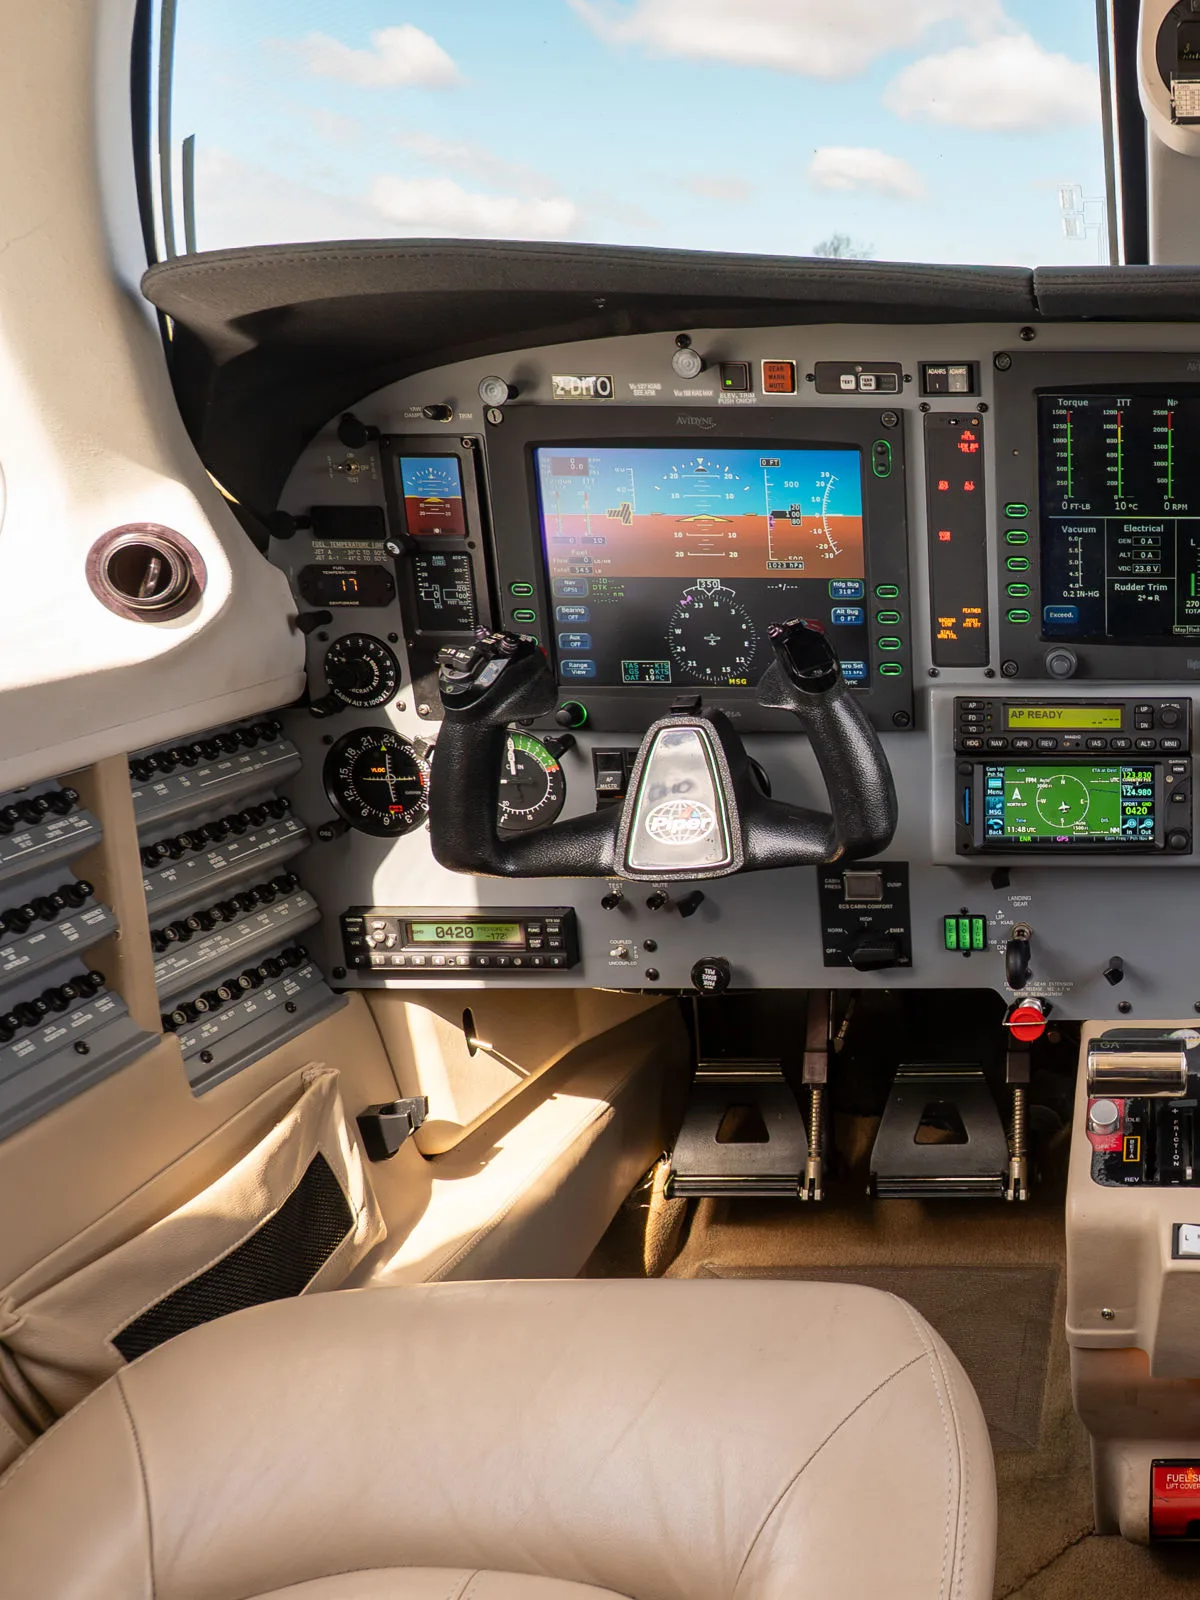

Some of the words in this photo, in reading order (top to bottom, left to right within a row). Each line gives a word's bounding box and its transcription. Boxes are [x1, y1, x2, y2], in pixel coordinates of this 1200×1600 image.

[1058, 399, 1088, 407] Torque
[1117, 399, 1132, 407] ITT
[676, 416, 714, 425] AVIDYNE
[1124, 524, 1164, 532] Electrical
[342, 578, 358, 591] 17
[700, 580, 718, 588] 350
[1114, 583, 1145, 591] Rudder
[334, 689, 351, 703] CABIN
[370, 697, 383, 705] 1000
[382, 690, 389, 699] FT
[1011, 710, 1025, 718] AP
[1028, 710, 1063, 719] READY
[361, 736, 373, 745] 21
[383, 734, 395, 742] 24
[340, 769, 348, 778] 15
[344, 790, 353, 801] 12
[9, 809, 18, 818] 5
[1125, 807, 1147, 815] 0420
[651, 816, 711, 832] Piper
[81, 884, 89, 892] 5
[436, 926, 473, 938] 0420
[38, 1002, 46, 1010] 5
[9, 1016, 17, 1025] 5
[1100, 1041, 1120, 1049] GA
[1167, 1474, 1188, 1482] FUEL
